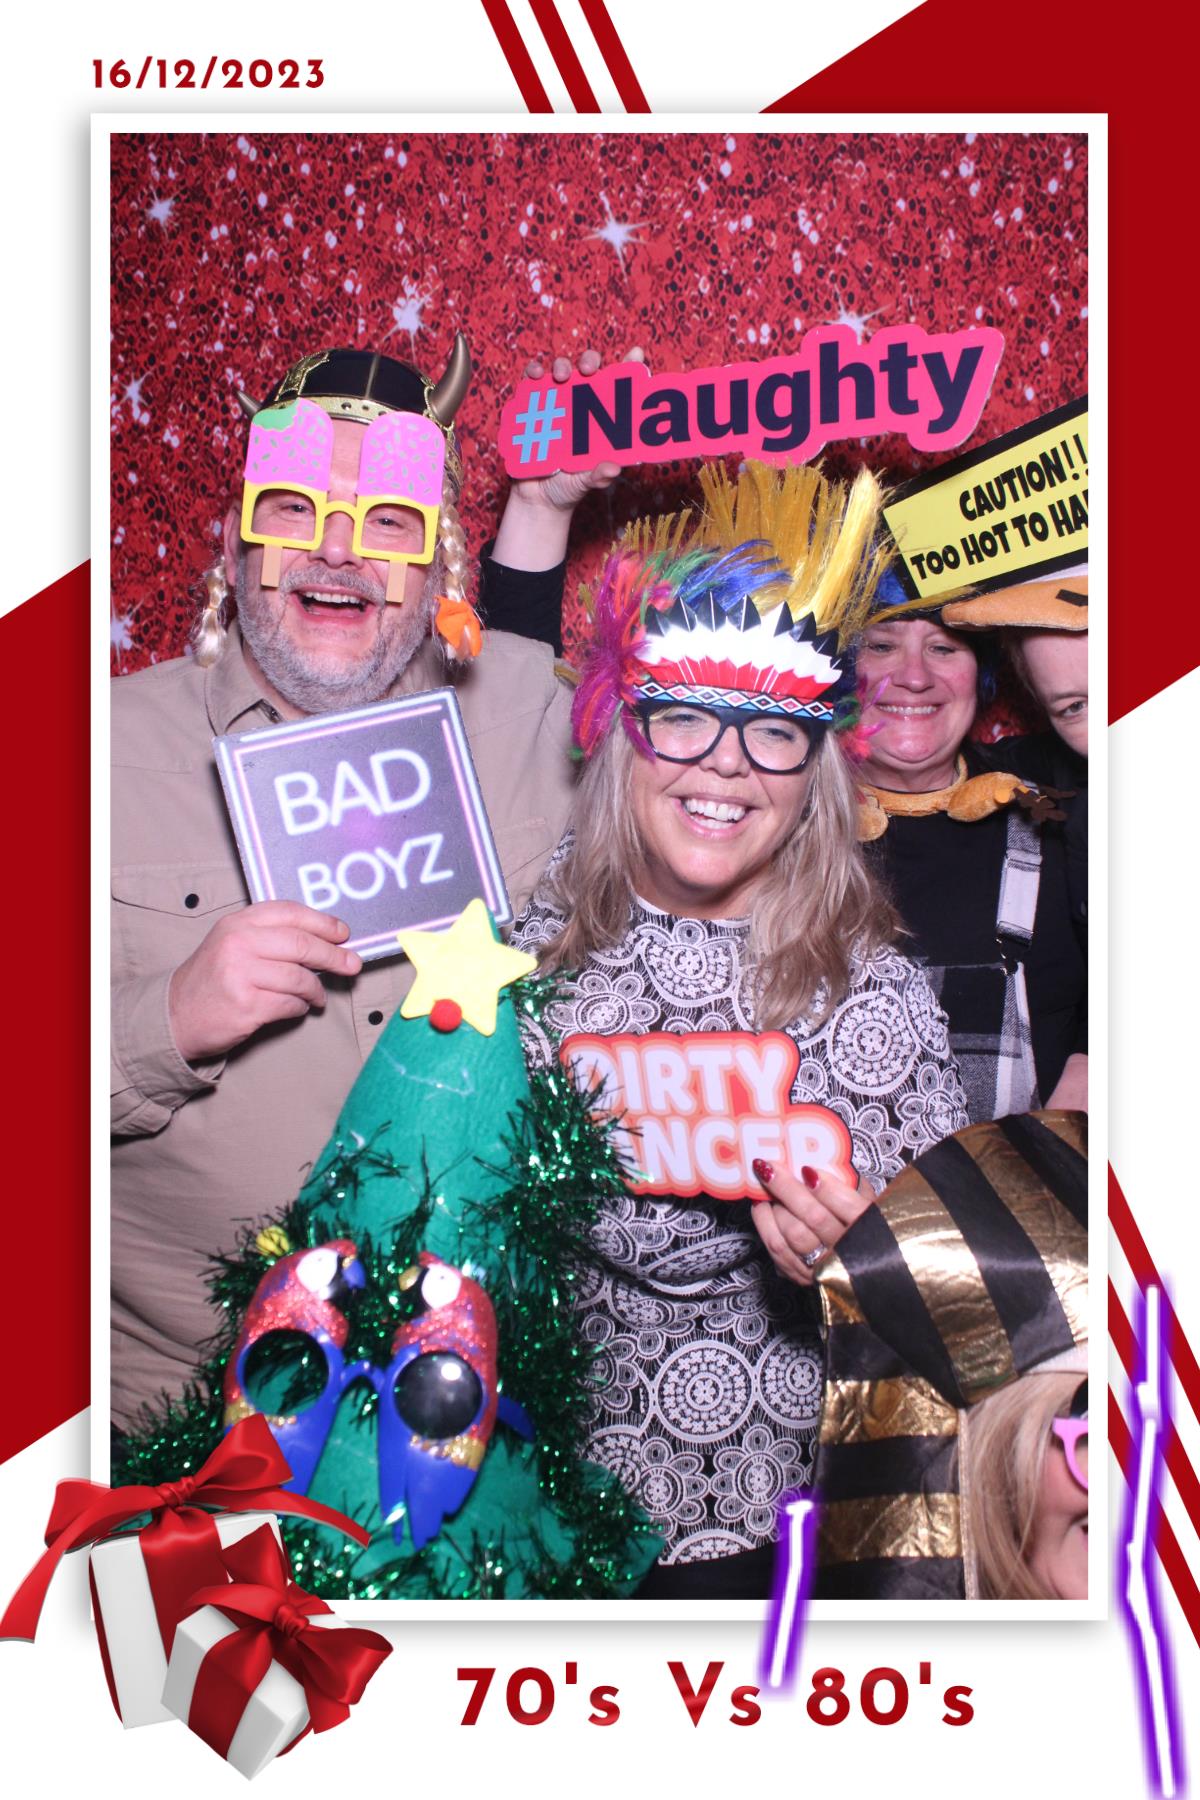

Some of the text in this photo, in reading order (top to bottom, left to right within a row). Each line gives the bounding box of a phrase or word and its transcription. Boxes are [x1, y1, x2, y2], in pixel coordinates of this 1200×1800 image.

[512, 341, 984, 464] #Naughty
[910, 489, 1088, 580] TOO HOT TO HA
[274, 749, 431, 836] BAD
[298, 833, 454, 910] BOYZ
[568, 1043, 784, 1114] DIRTY
[603, 1120, 845, 1186] ANCER
